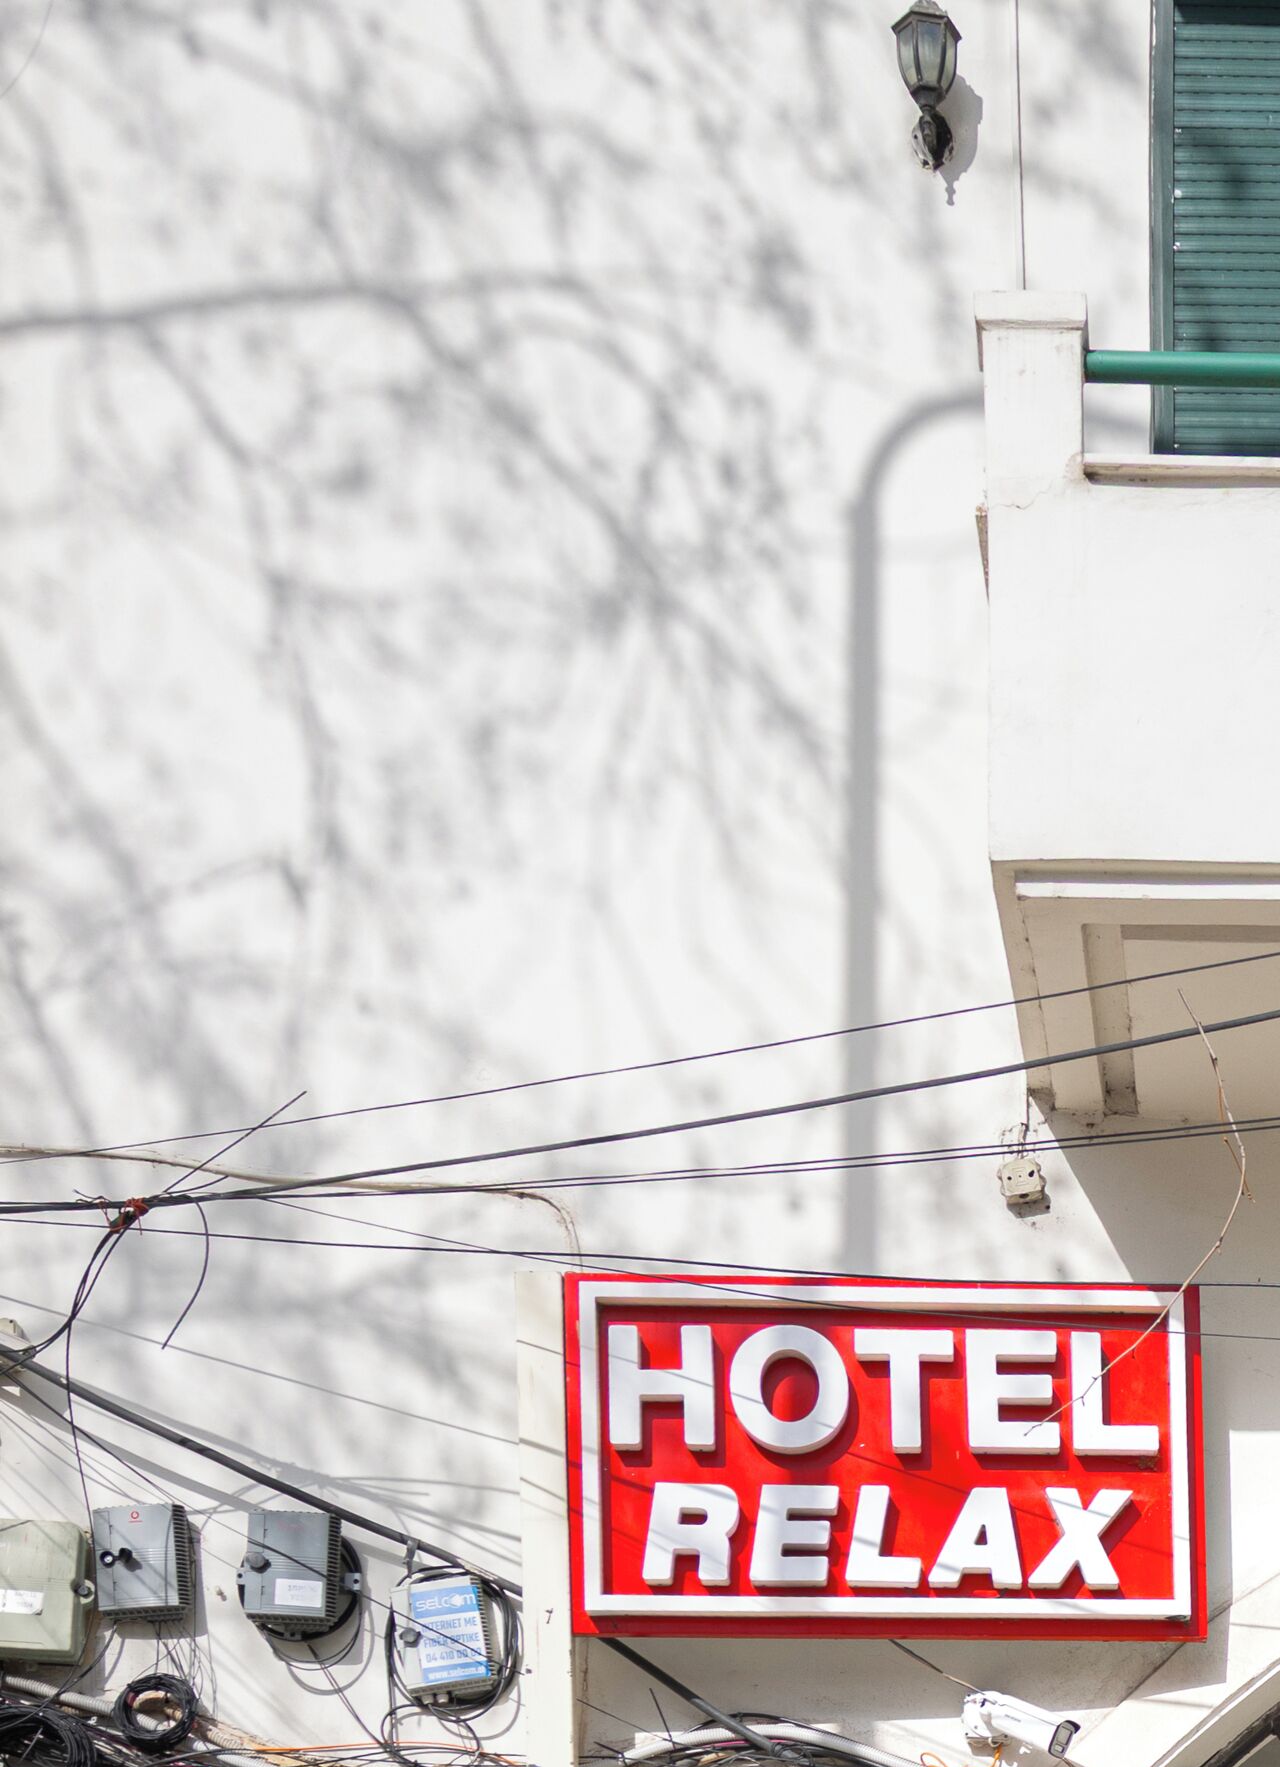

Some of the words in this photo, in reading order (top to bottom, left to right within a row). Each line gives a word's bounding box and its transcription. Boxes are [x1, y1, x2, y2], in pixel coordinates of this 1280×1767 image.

[607, 1324, 1160, 1456] HOTEL
[641, 1481, 1134, 1591] RELAX
[463, 1616, 478, 1627] ME
